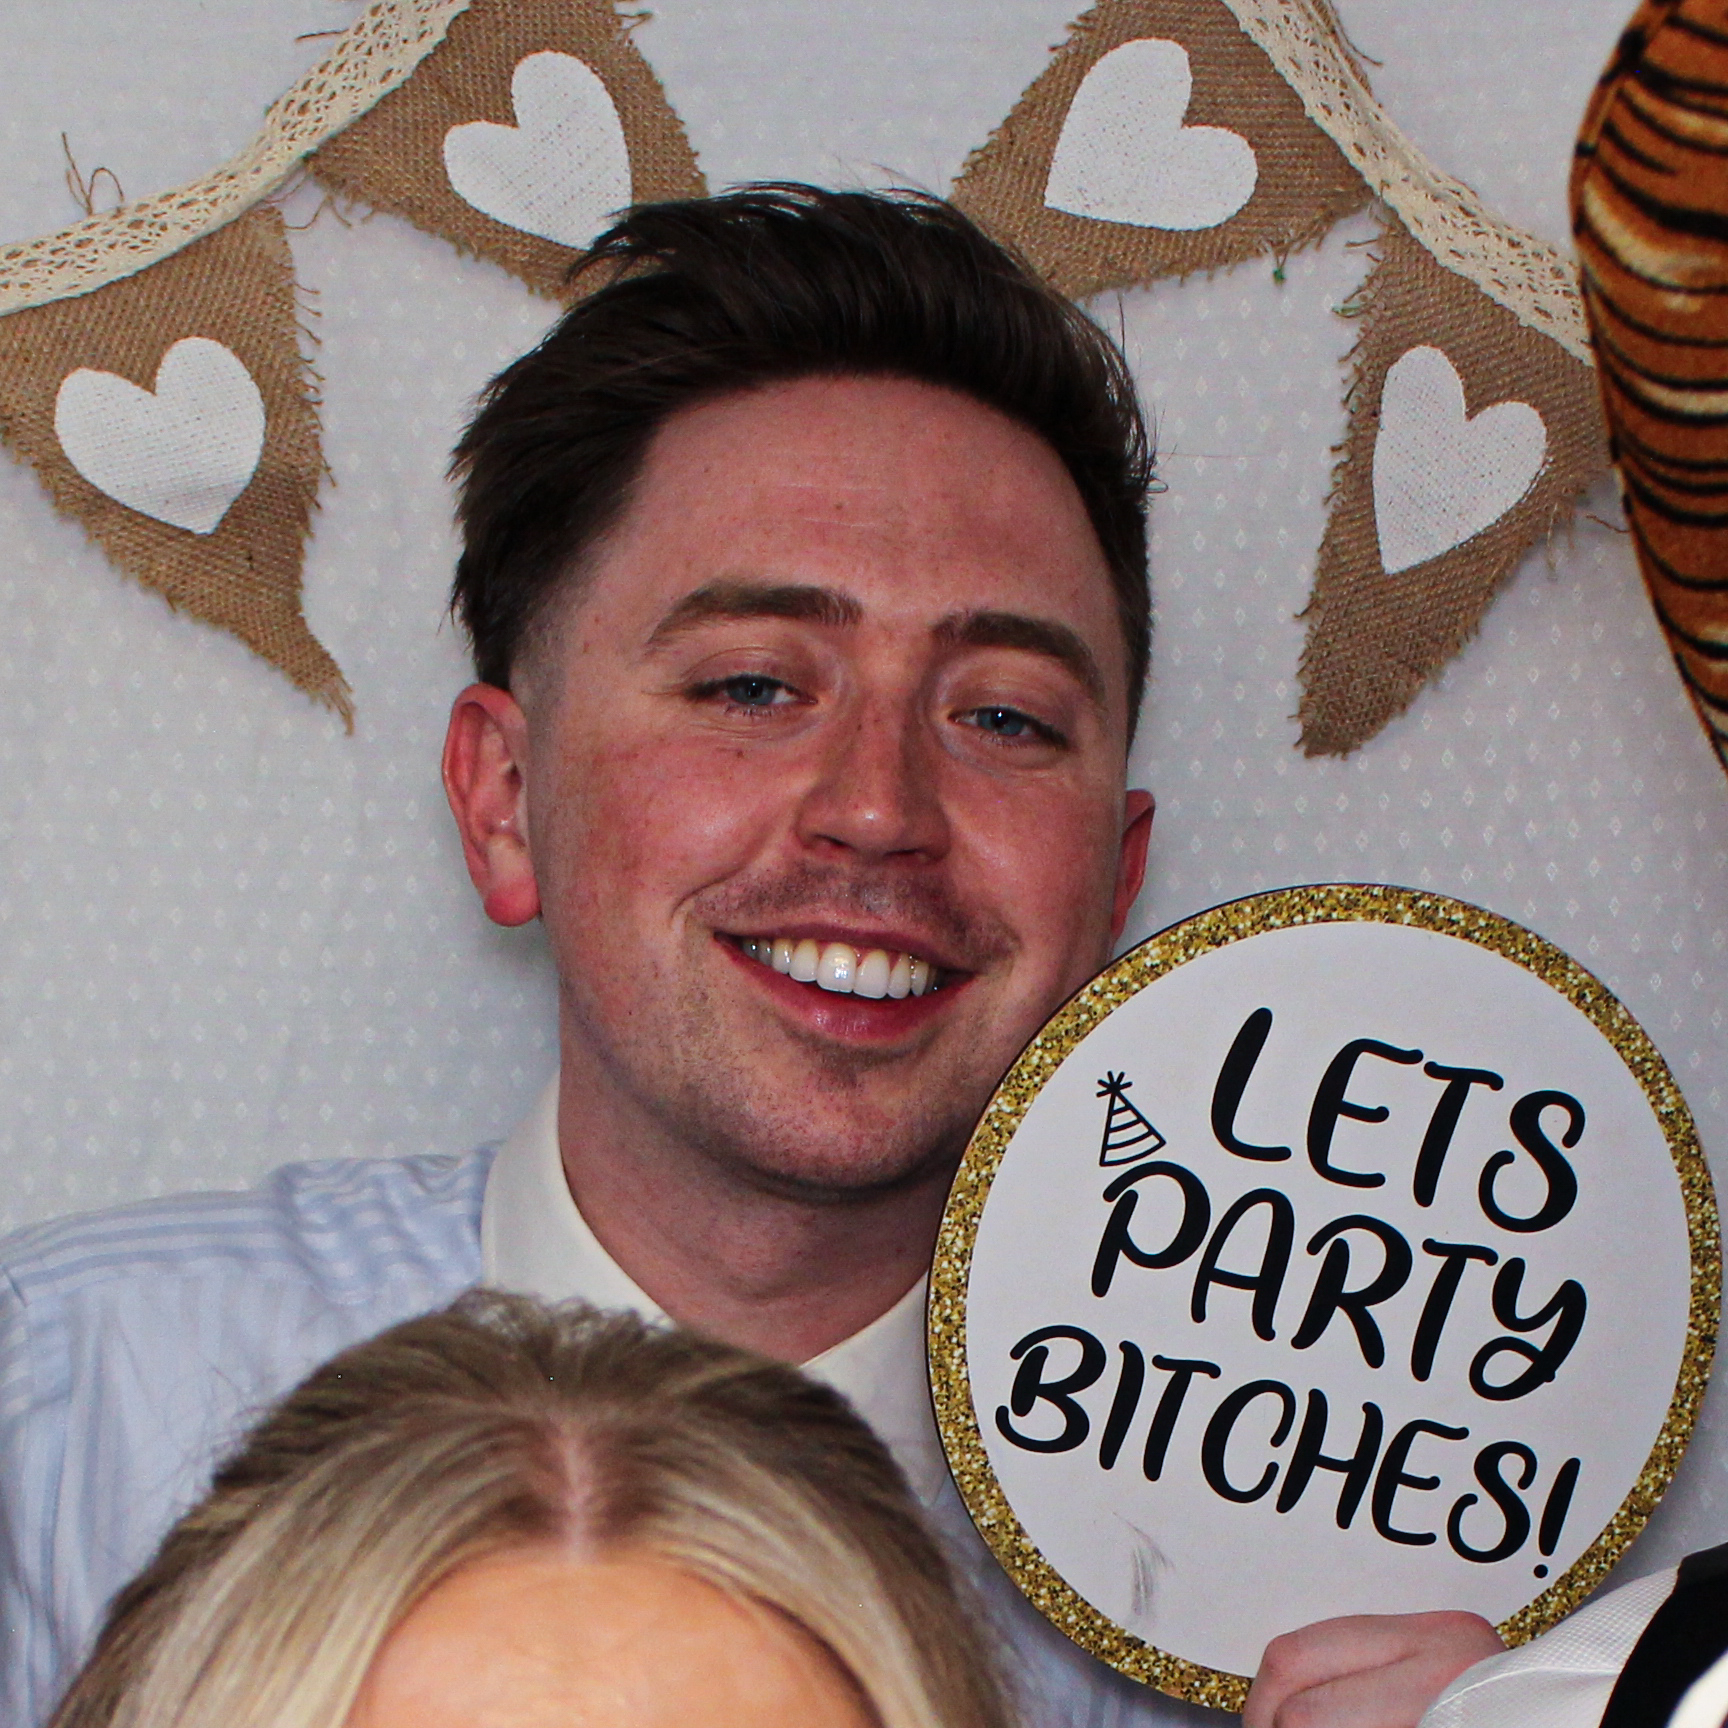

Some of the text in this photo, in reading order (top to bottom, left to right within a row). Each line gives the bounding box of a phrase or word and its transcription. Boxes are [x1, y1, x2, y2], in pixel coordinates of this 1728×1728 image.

[1210, 1007, 1586, 1233] LETS
[1090, 1160, 1588, 1401] PARTY
[995, 1324, 1582, 1579] BITCHES!
